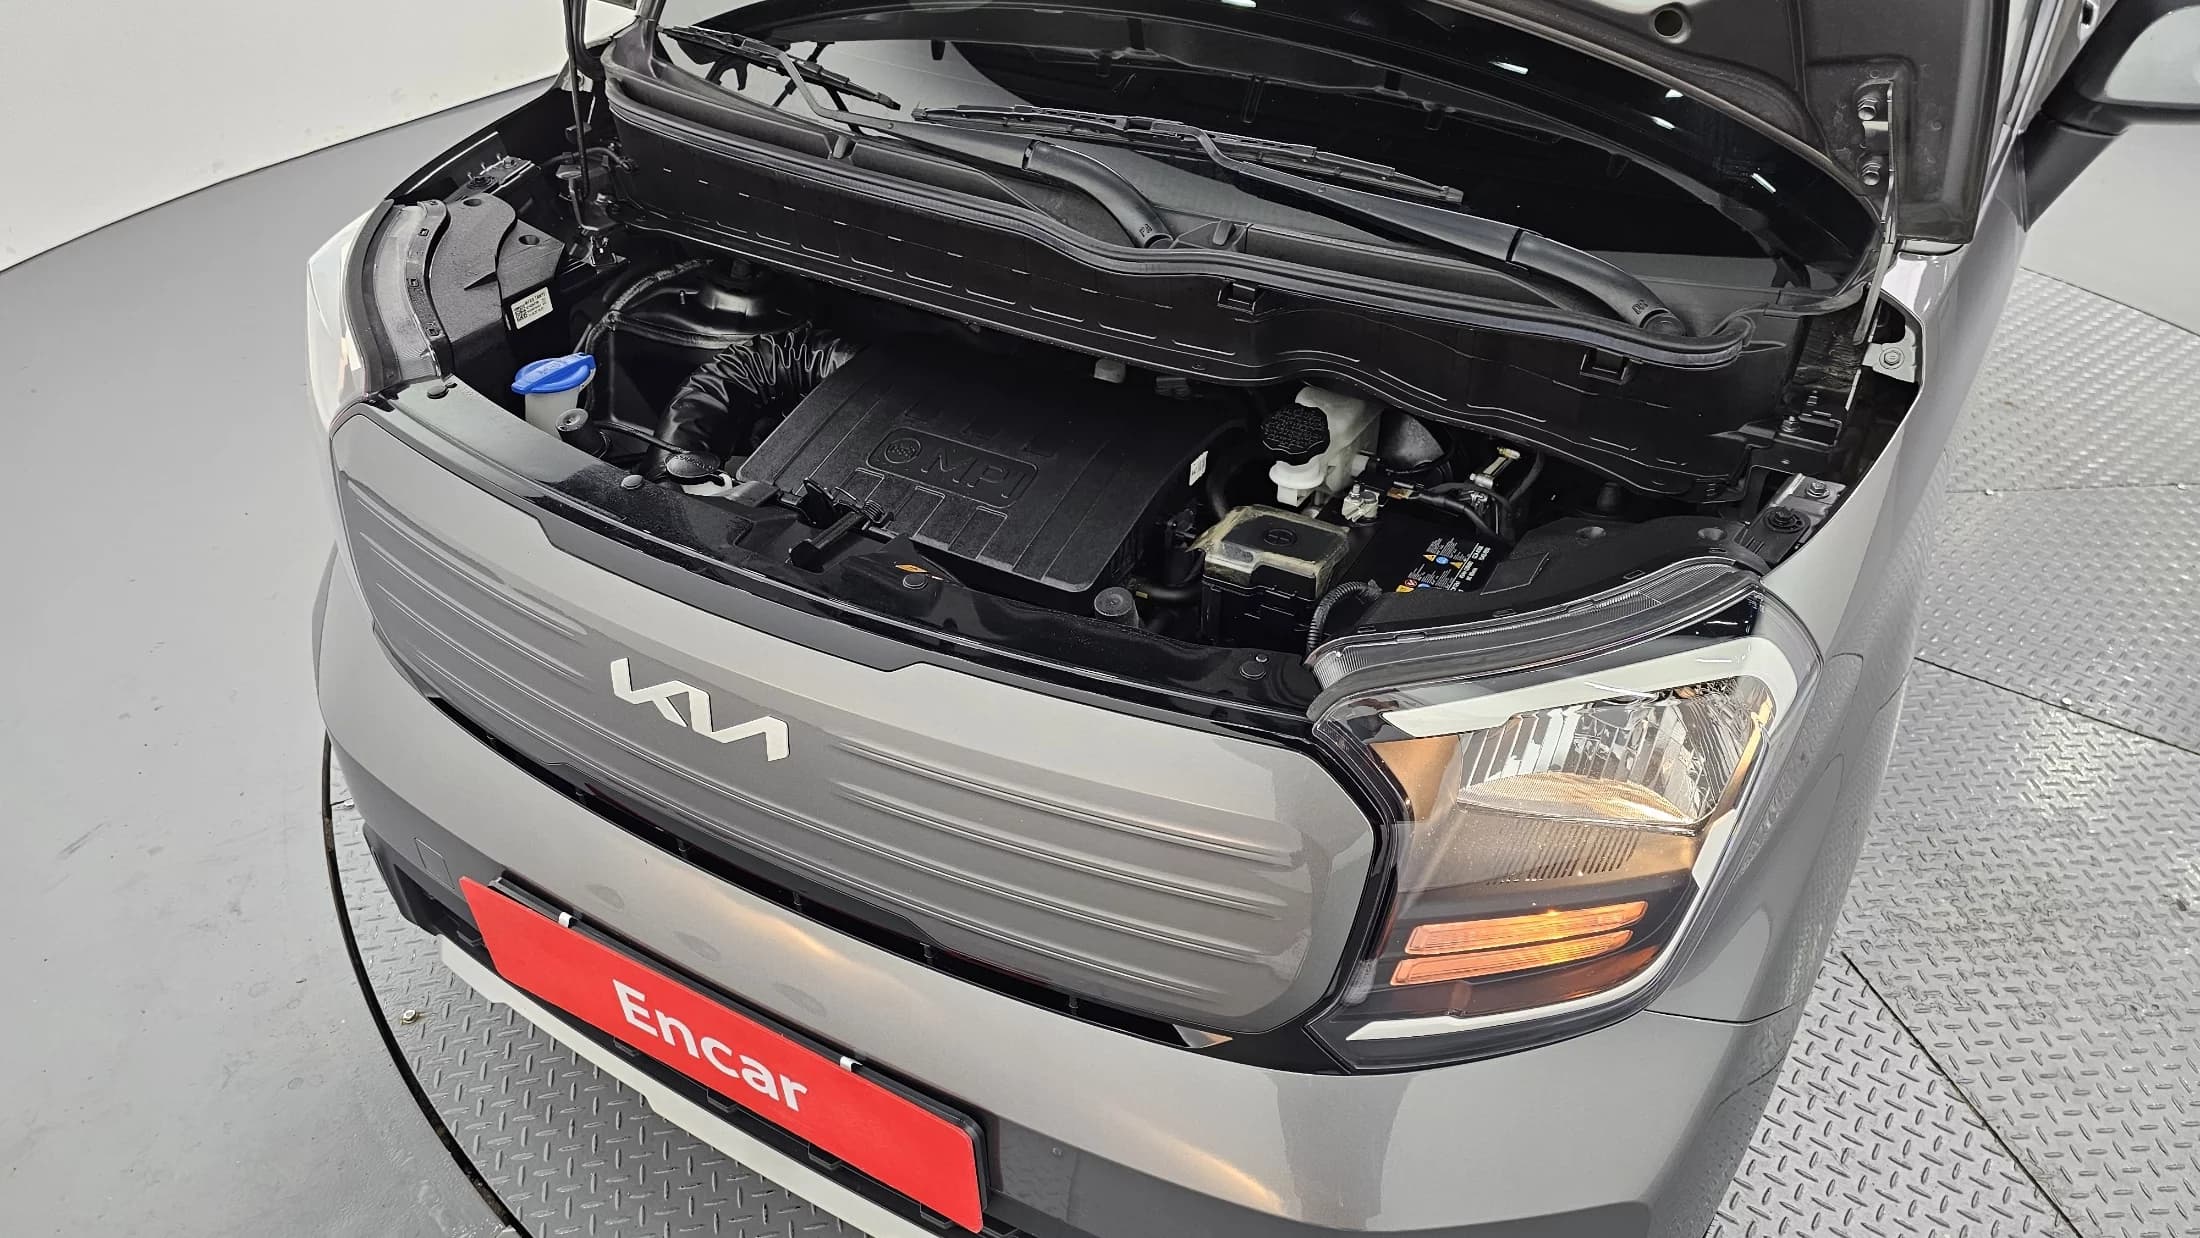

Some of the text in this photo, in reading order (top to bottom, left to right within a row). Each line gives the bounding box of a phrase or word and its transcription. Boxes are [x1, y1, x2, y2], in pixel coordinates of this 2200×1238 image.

[921, 449, 1027, 499] MPI
[611, 657, 790, 762] KIA
[612, 979, 808, 1112] Encar
